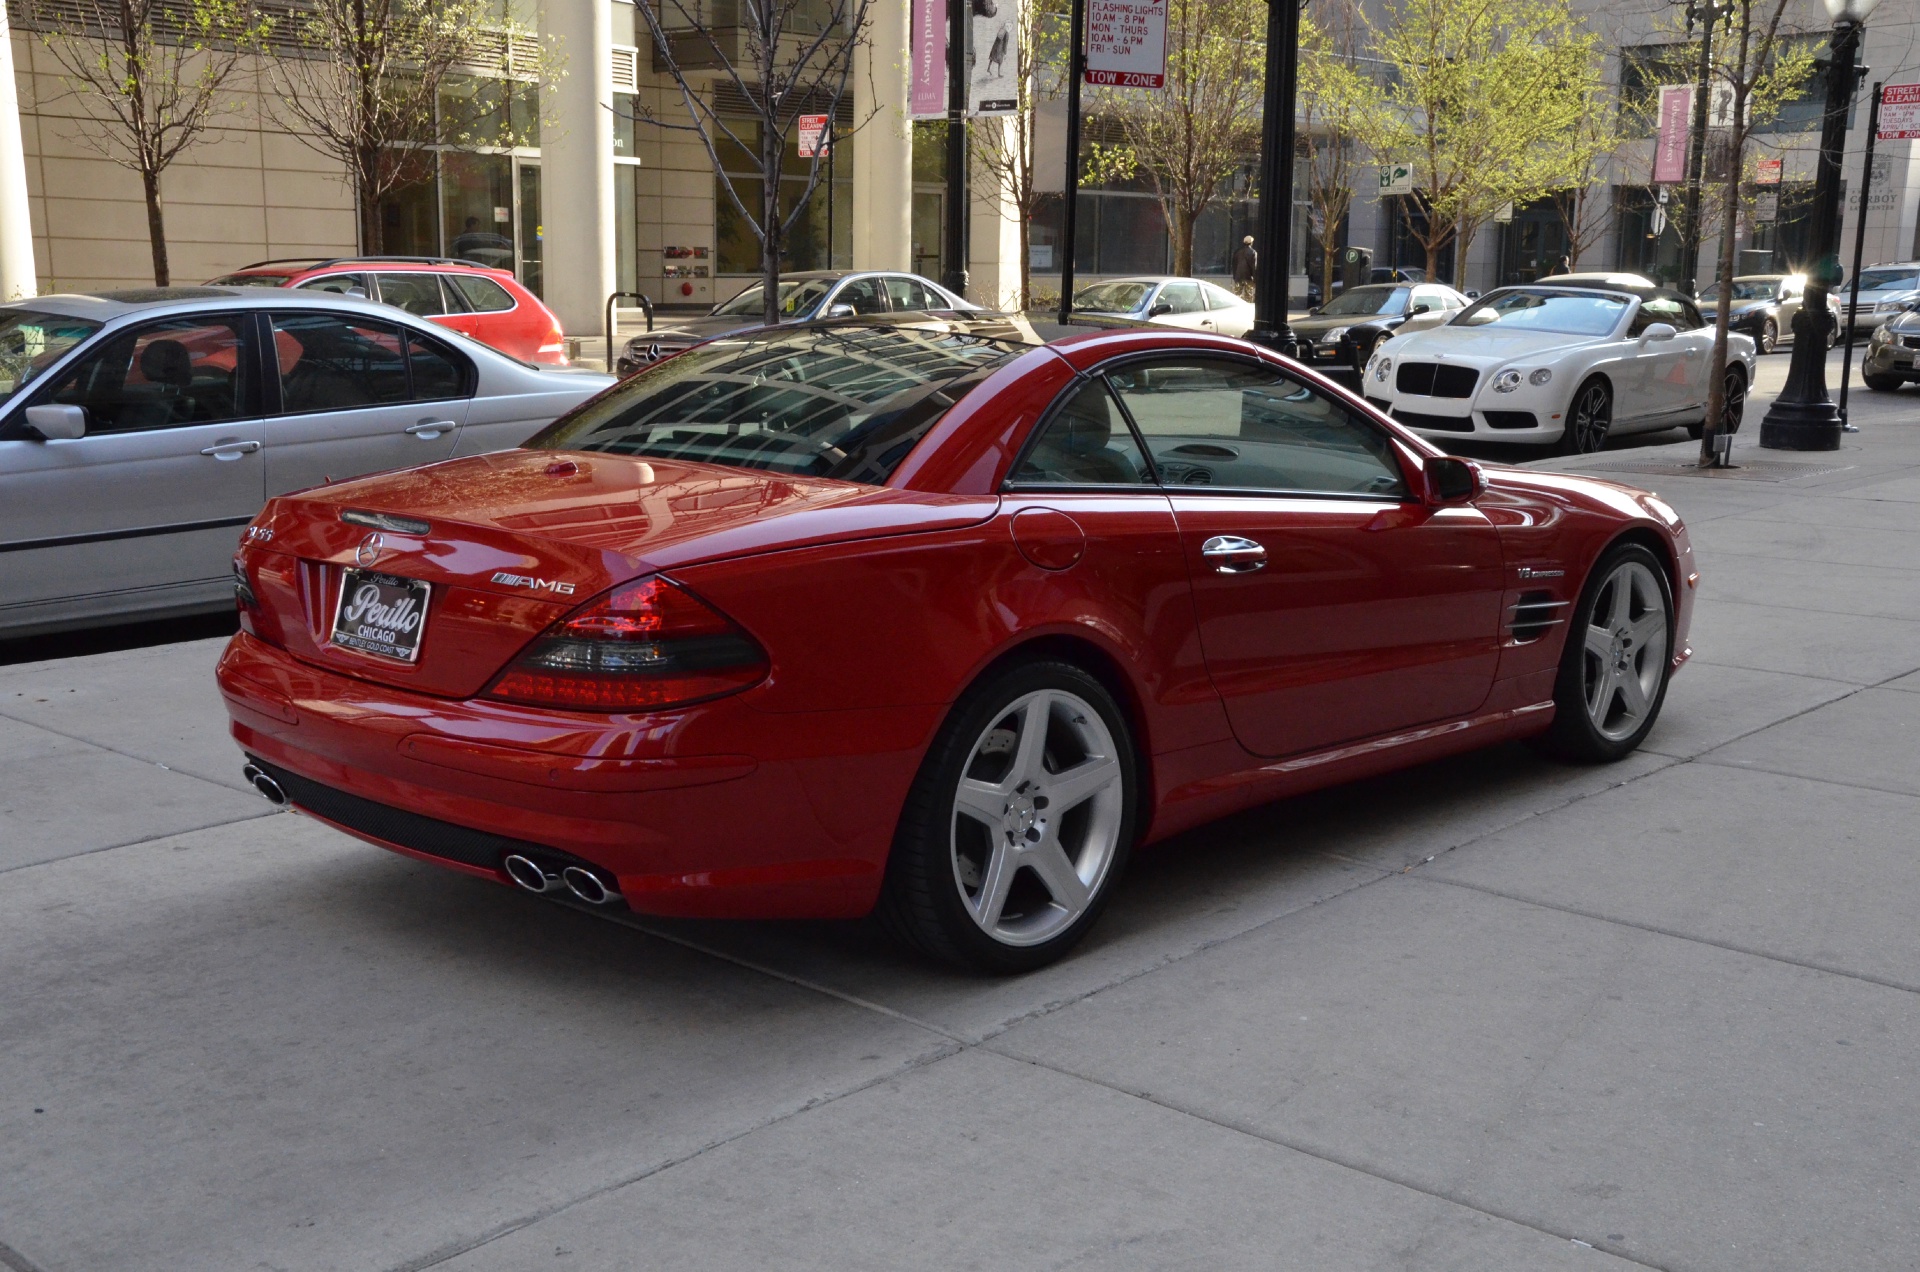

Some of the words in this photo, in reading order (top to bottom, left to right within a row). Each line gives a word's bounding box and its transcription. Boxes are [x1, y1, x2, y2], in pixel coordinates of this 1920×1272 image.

[1092, 2, 1133, 14] FLASHING
[1134, 5, 1164, 16] LIGHTS
[1124, 14, 1130, 24] 8
[1132, 15, 1145, 24] PM
[1091, 23, 1110, 32] MON
[1120, 24, 1149, 36] THURS
[1122, 36, 1128, 44] 6
[1130, 36, 1143, 45] PM
[1090, 44, 1105, 53] FRI
[1112, 45, 1131, 55] SUN
[920, 41, 934, 85] Gorey
[1089, 71, 1117, 84] TOW
[1123, 73, 1157, 87] ZONE
[1886, 86, 1920, 96] STREET
[1881, 131, 1900, 139] TOW
[1850, 194, 1898, 204] CRBOY
[371, 573, 399, 587] Perillo
[516, 575, 576, 595] AMG
[344, 584, 419, 634] Perillo
[357, 624, 396, 643] CHICAGO
[348, 637, 367, 648] BENTLEY
[367, 641, 380, 651] GOLD
[380, 644, 395, 654] COAST
